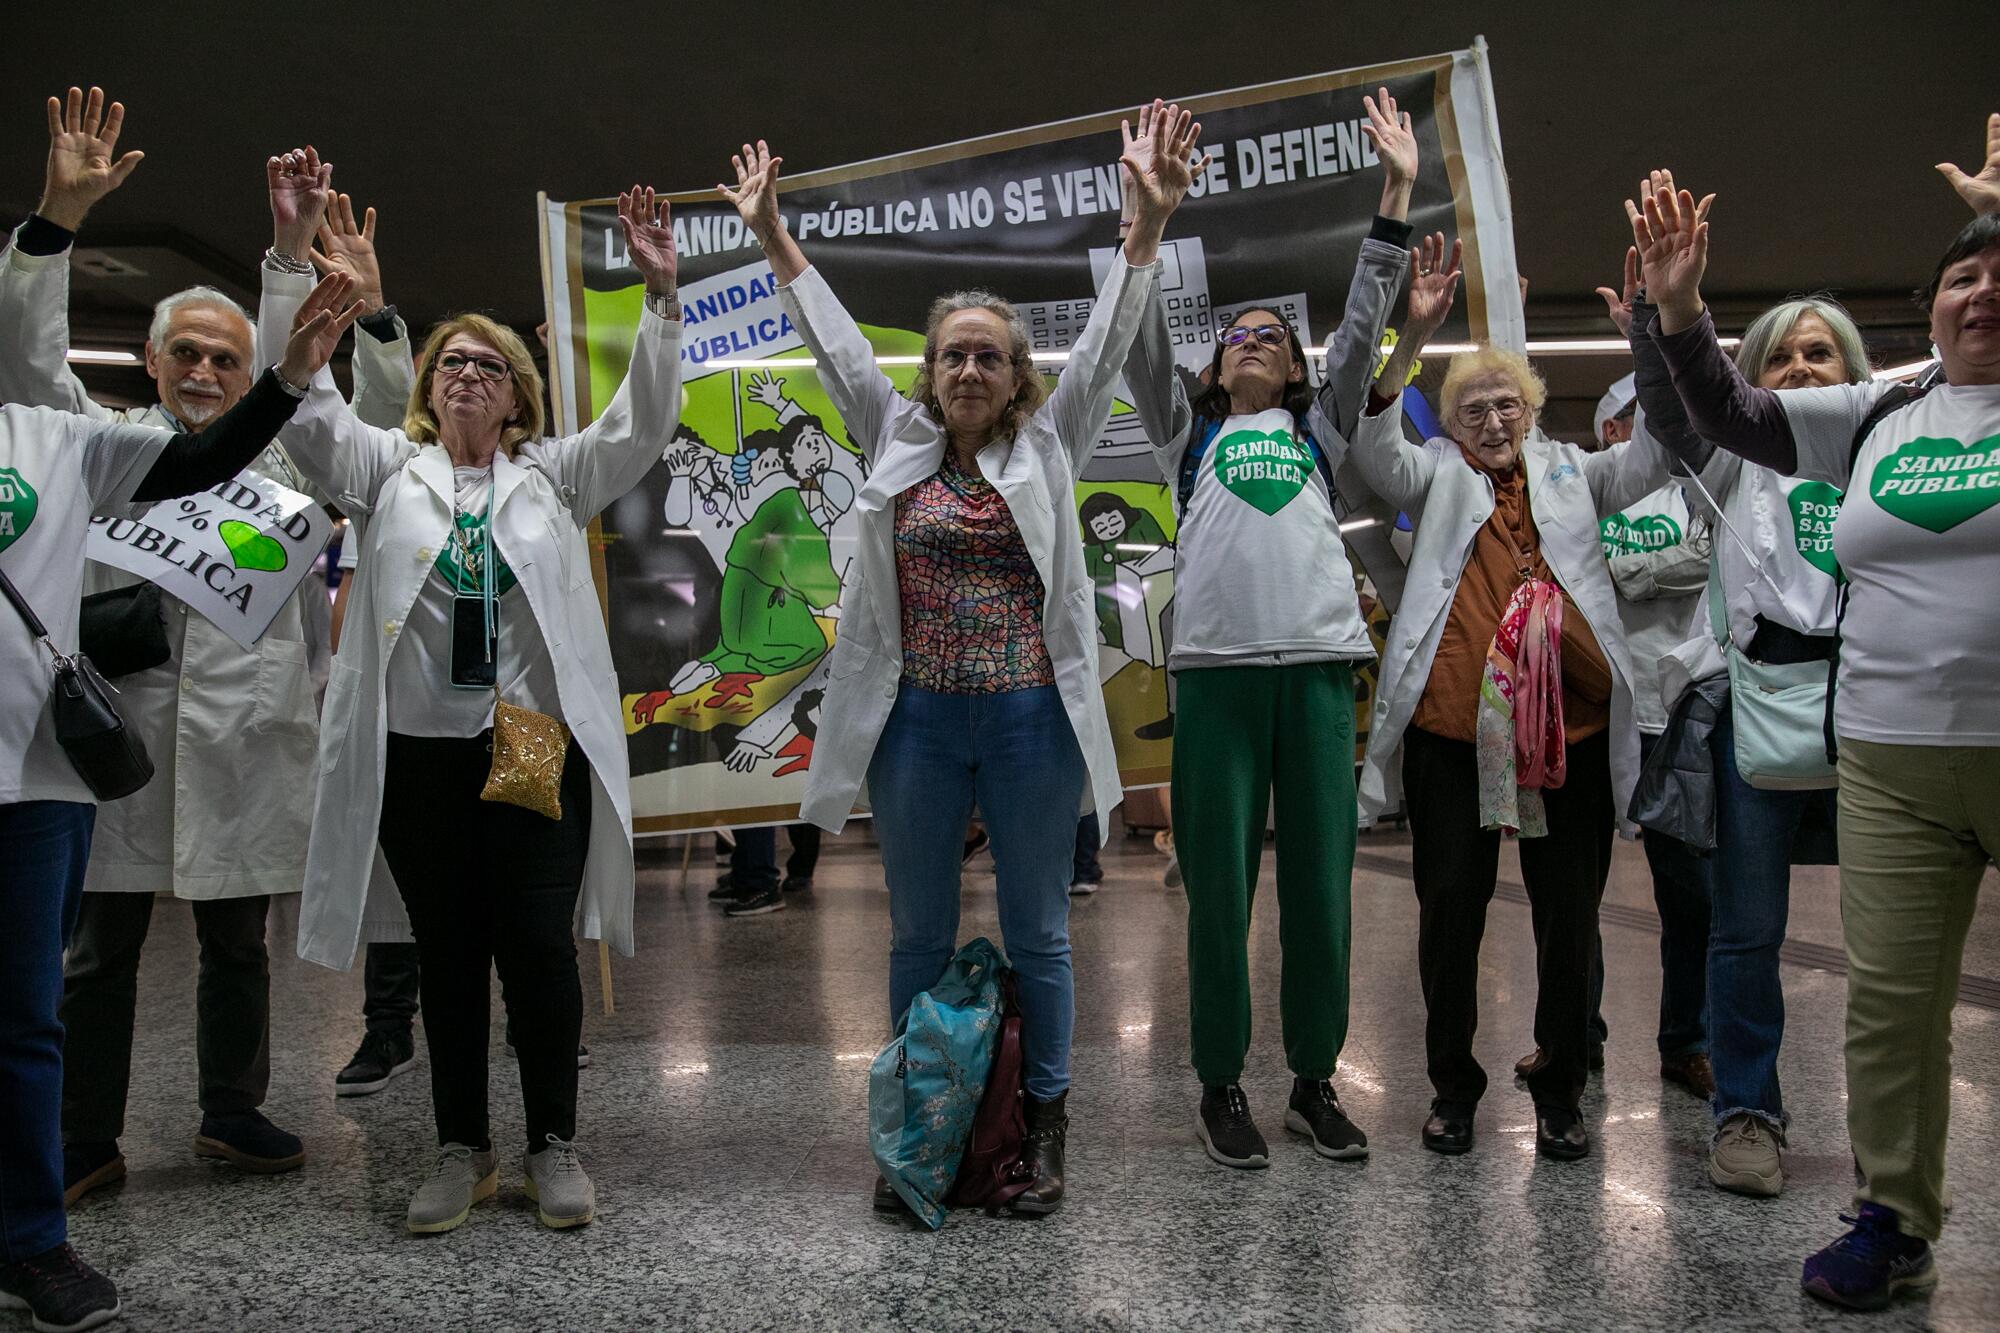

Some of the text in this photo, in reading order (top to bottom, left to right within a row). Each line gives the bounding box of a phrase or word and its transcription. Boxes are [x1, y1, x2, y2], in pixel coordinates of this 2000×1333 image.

[798, 198, 939, 240] PÚBLICA
[947, 186, 994, 230] NO
[1003, 177, 1047, 225] SE
[1051, 162, 1121, 218] VEN
[1236, 111, 1404, 190] DEFIEND
[682, 272, 778, 328] ANIDA
[1226, 457, 1302, 485] PÚBLICA
[1891, 447, 2000, 474] SANIDA
[1875, 471, 2000, 497] PÚBLIC
[210, 479, 311, 542] IDAD
[1798, 535, 1834, 553] PÚ
